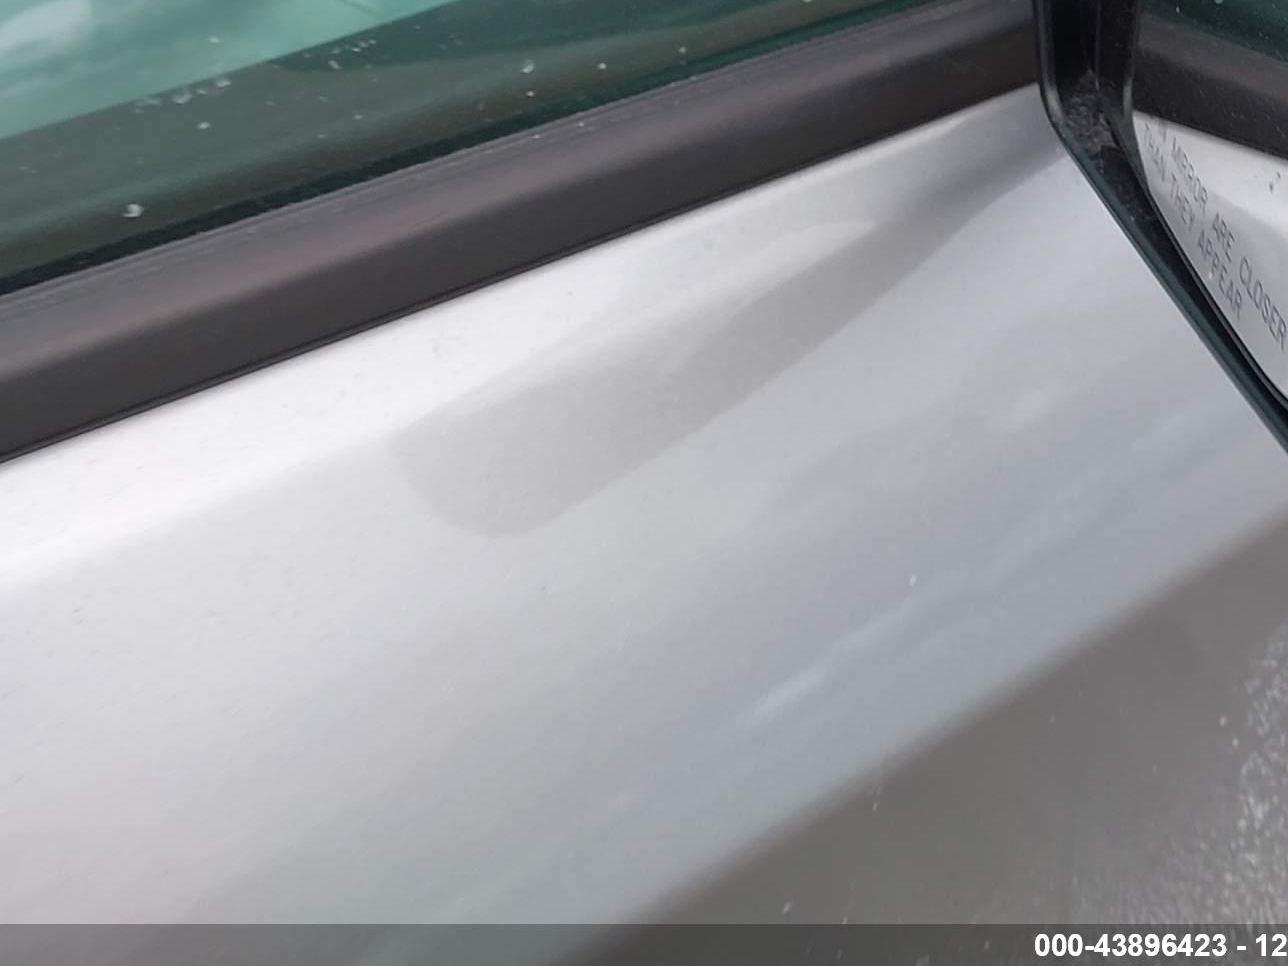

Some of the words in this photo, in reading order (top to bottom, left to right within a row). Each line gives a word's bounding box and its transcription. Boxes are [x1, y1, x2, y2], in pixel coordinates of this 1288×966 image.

[1170, 172, 1196, 233] THEY
[1197, 229, 1243, 320] APPEAR
[1212, 211, 1236, 263] ARE
[1239, 257, 1288, 351] CLOSER
